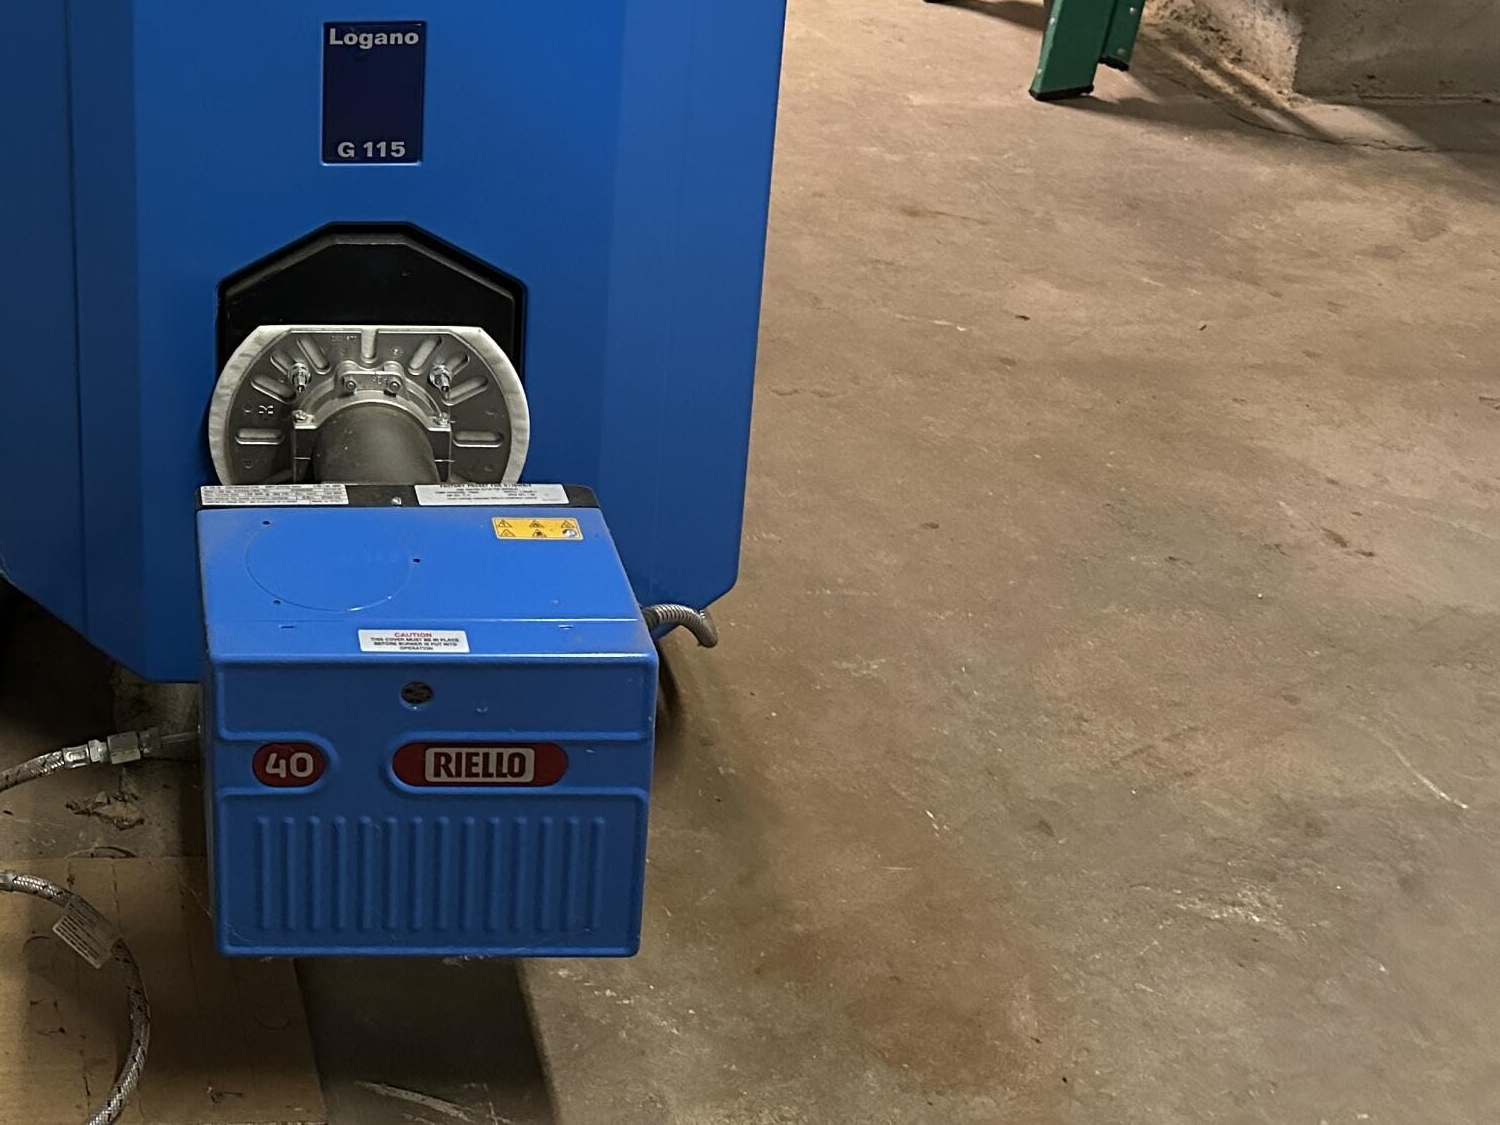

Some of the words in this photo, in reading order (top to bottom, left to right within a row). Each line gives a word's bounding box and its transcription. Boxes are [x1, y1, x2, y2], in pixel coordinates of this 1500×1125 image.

[329, 27, 419, 50] Logano
[337, 141, 356, 158] G
[363, 141, 406, 158] 115
[265, 752, 314, 778] 40
[434, 751, 527, 778] RIELLO
